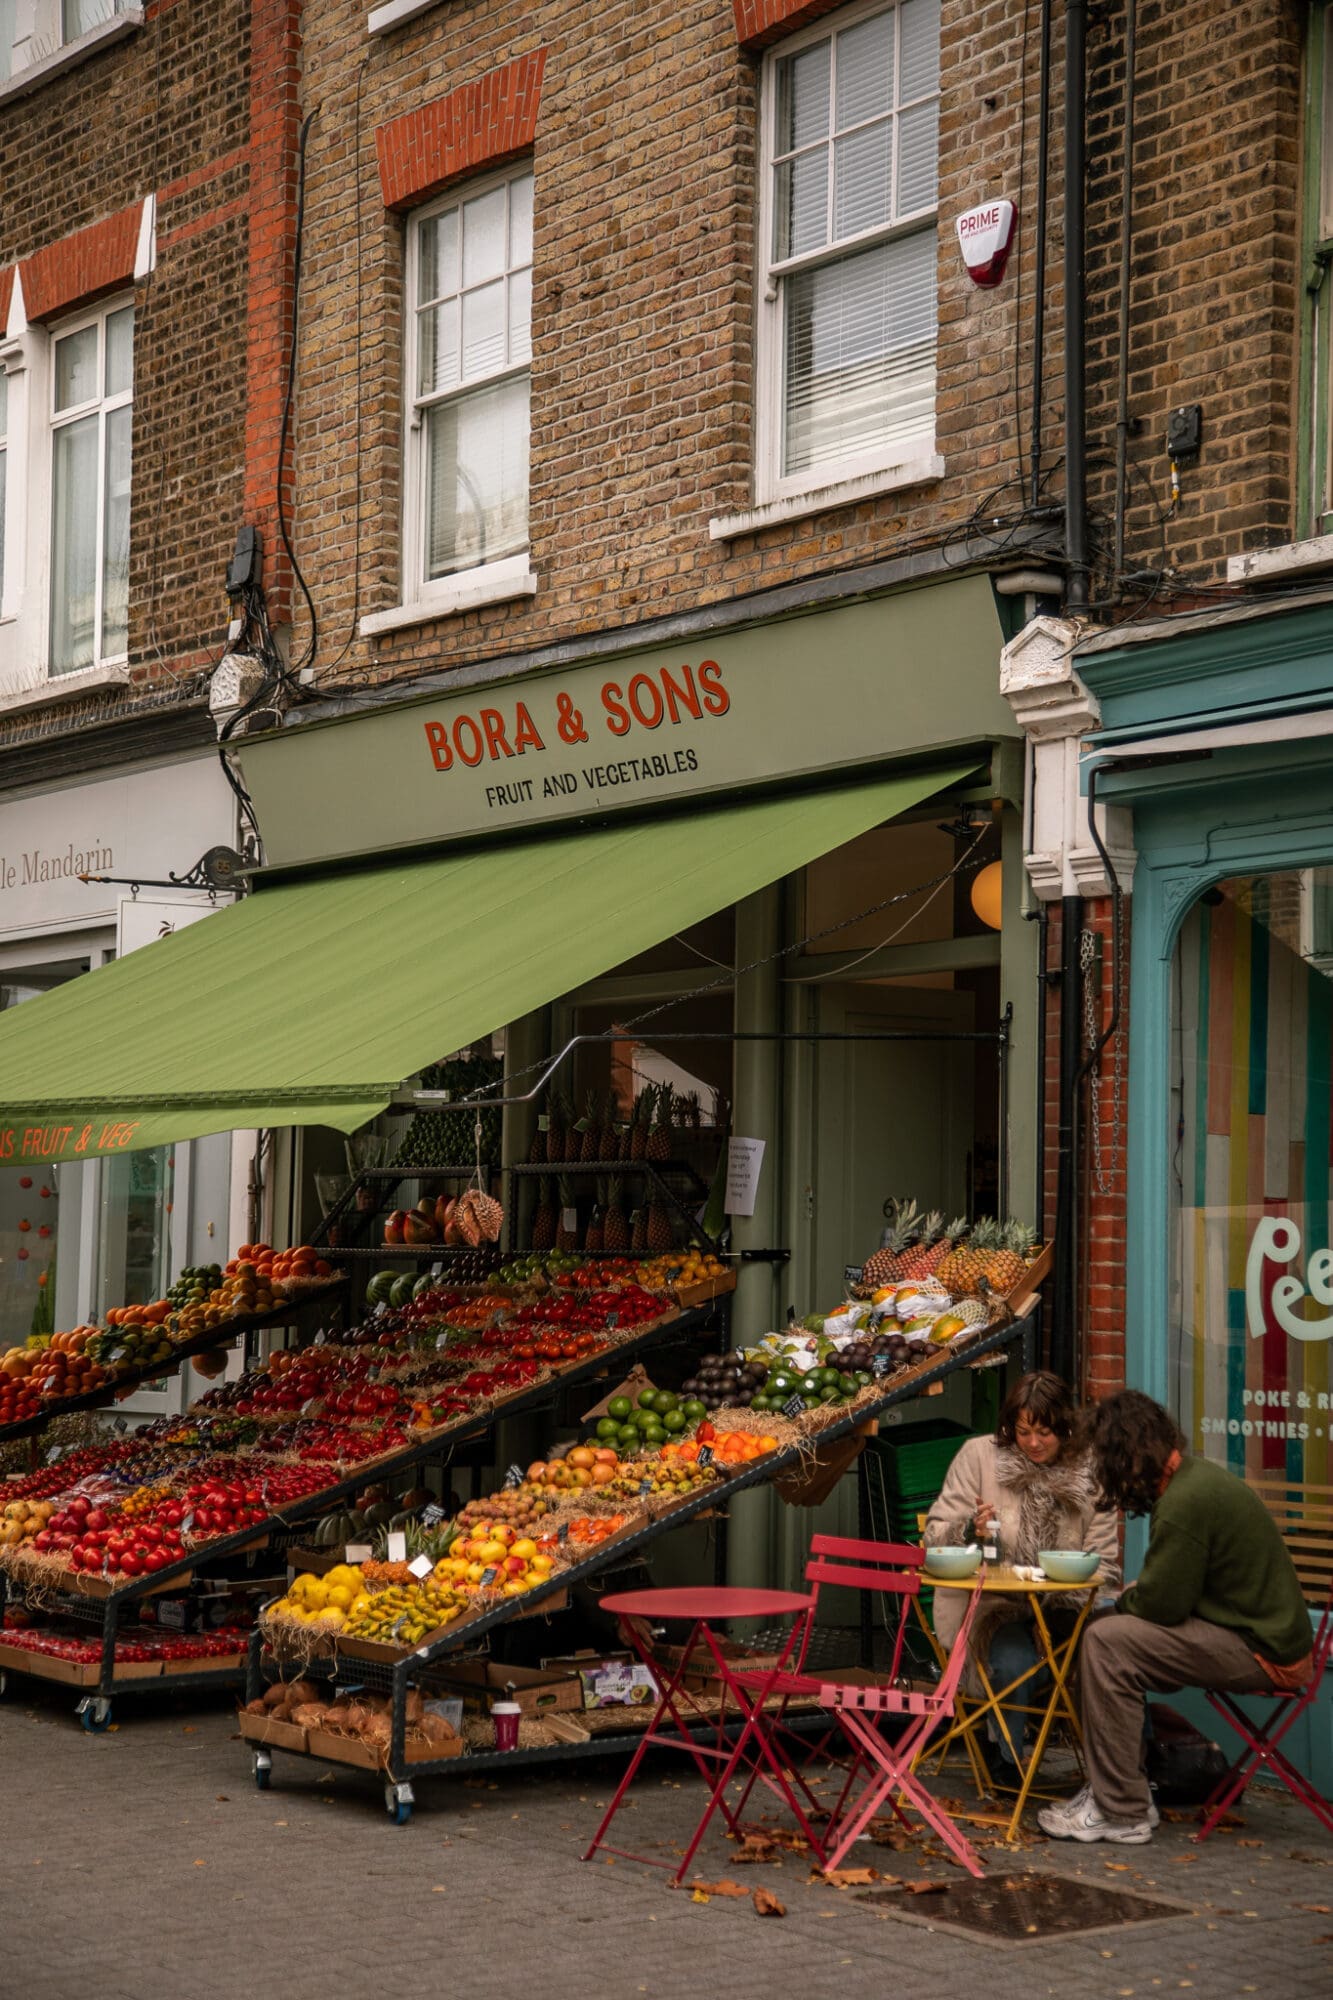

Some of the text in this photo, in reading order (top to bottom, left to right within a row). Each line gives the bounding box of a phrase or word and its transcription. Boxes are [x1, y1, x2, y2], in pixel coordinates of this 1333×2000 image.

[960, 207, 999, 235] PRIME
[424, 660, 730, 771] BORA & SONS
[485, 749, 698, 808] FRUIT AND VEGETABLES
[21, 838, 114, 886] Mandarin
[21, 1126, 74, 1157] FRUIT
[74, 1124, 94, 1153] &
[98, 1122, 140, 1149] VEG
[1242, 1389, 1333, 1410] POKE & R
[1200, 1416, 1310, 1440] SMOOTHIES
